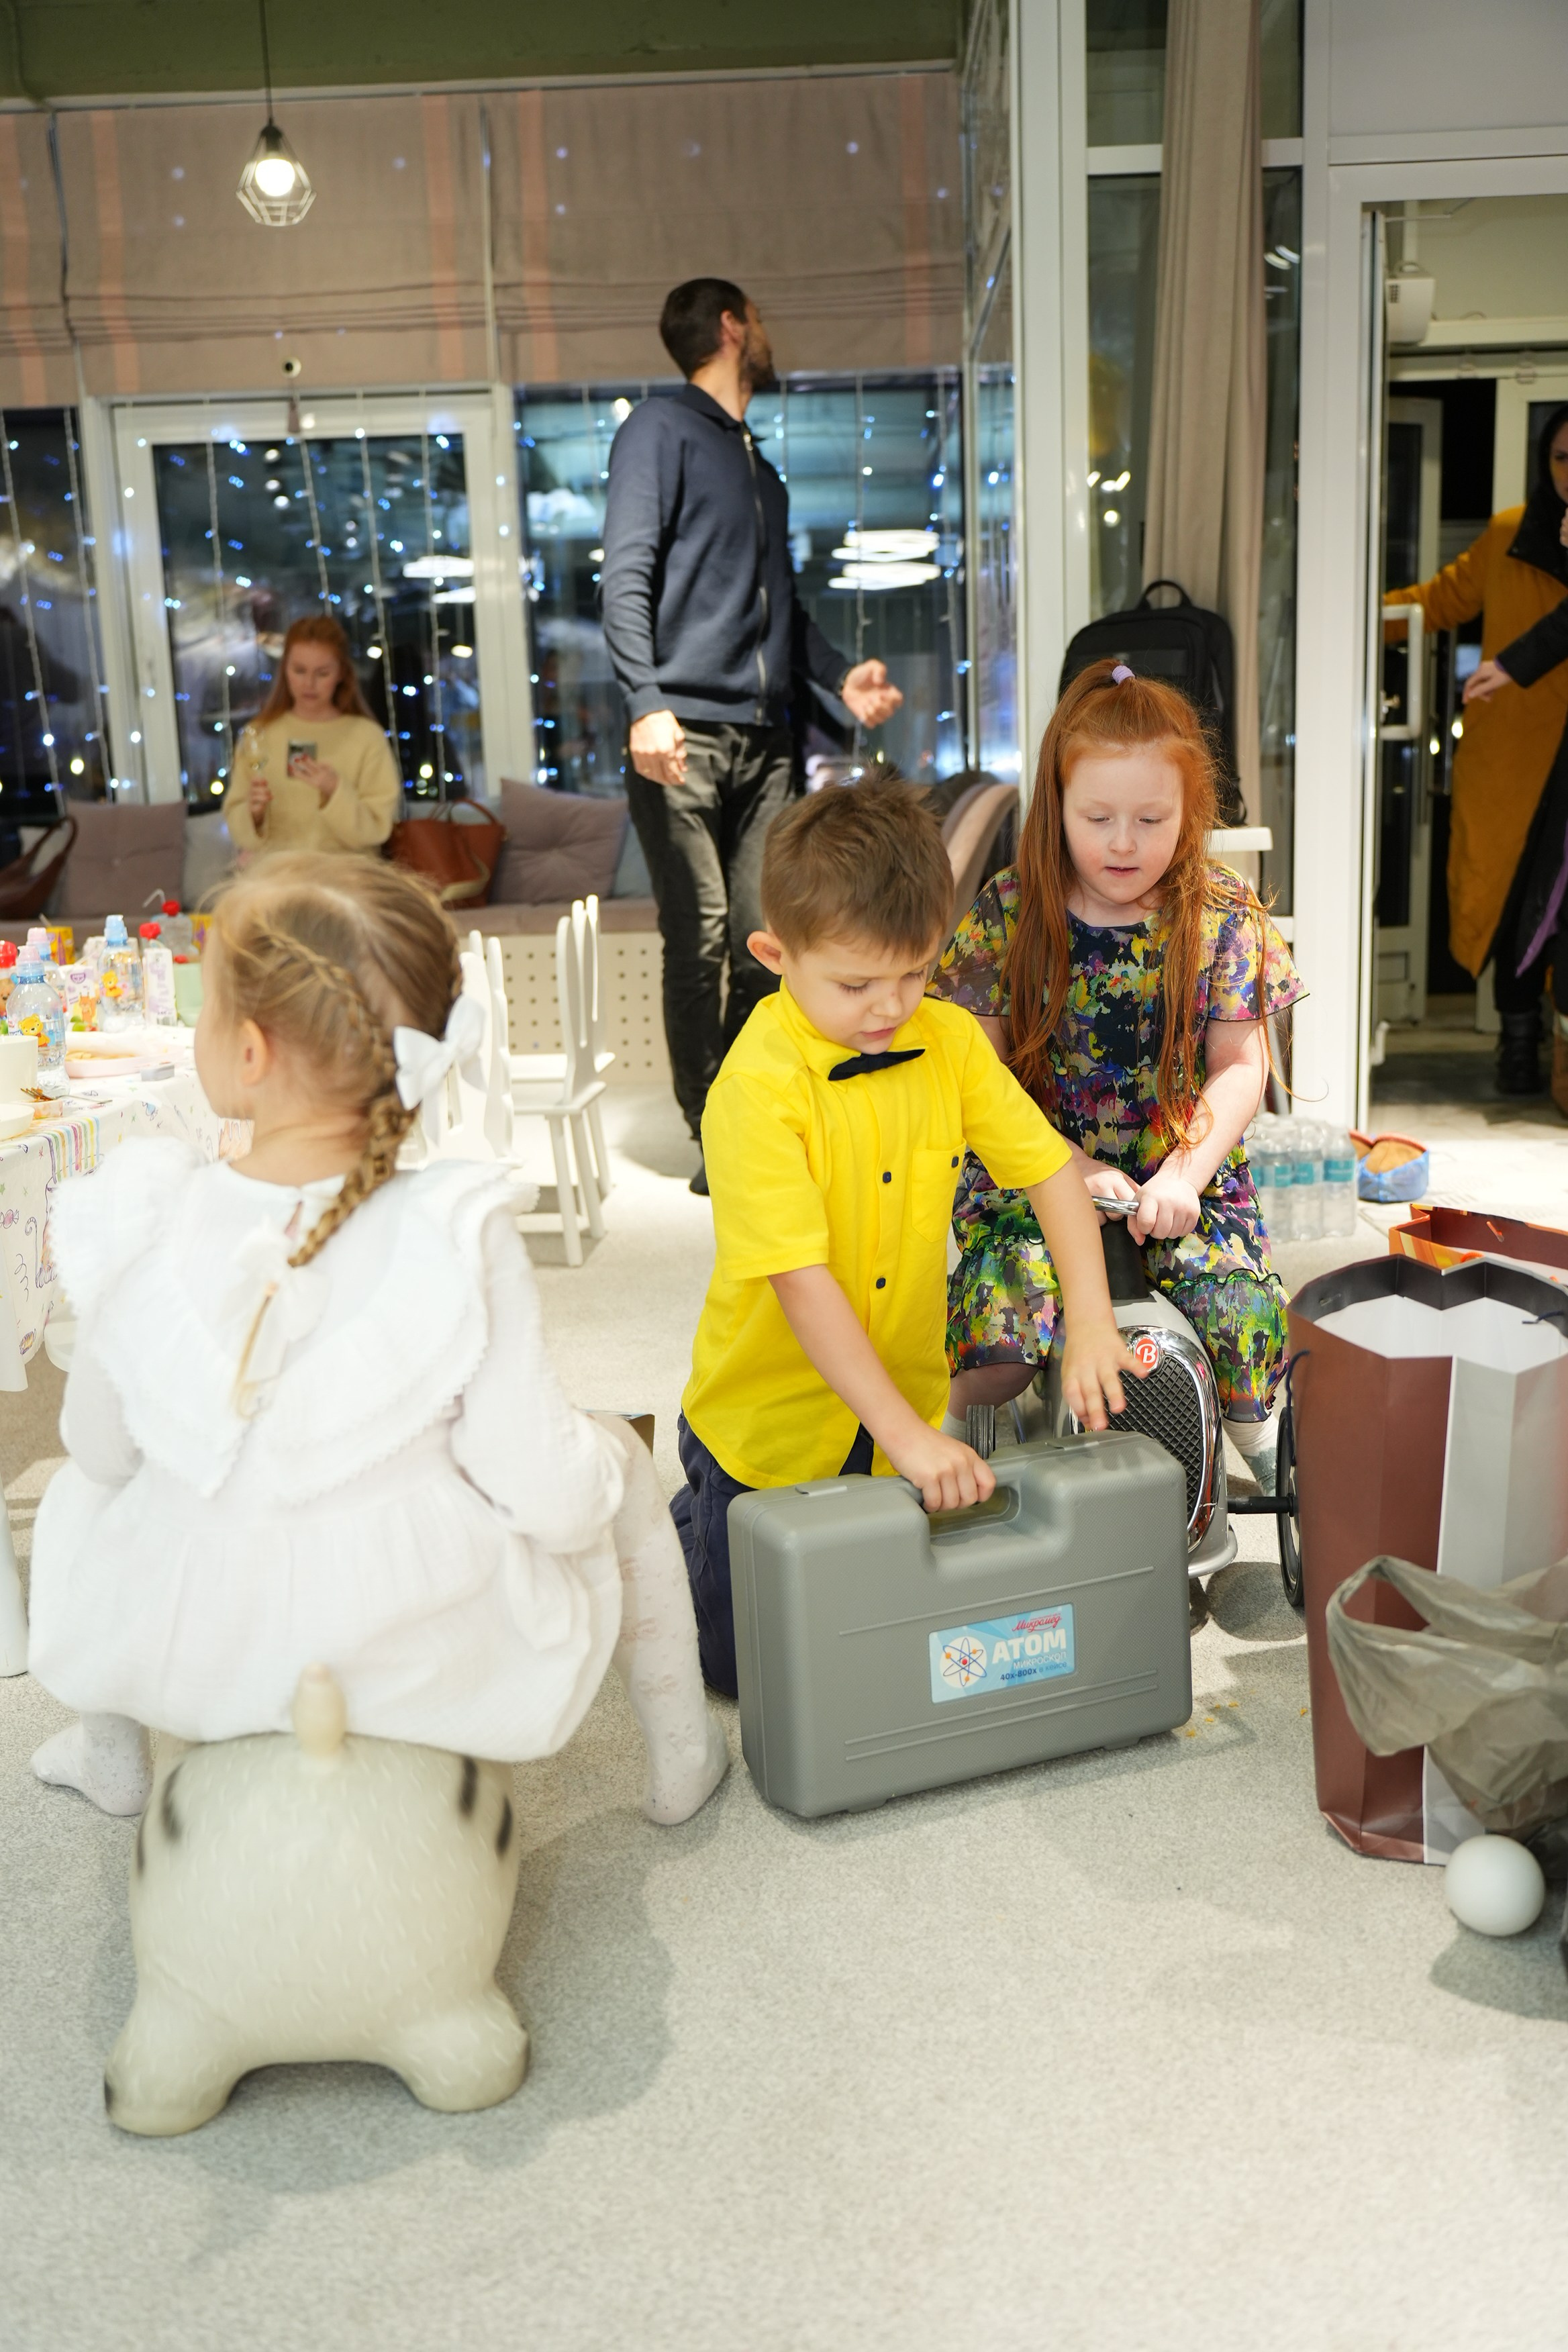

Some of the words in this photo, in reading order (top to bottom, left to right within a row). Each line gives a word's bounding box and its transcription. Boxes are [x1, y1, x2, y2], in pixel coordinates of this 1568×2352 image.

[1136, 1343, 1157, 1364] B
[992, 1628, 1067, 1664] АТОМ
[1014, 1651, 1067, 1669] МИКРОСКОП
